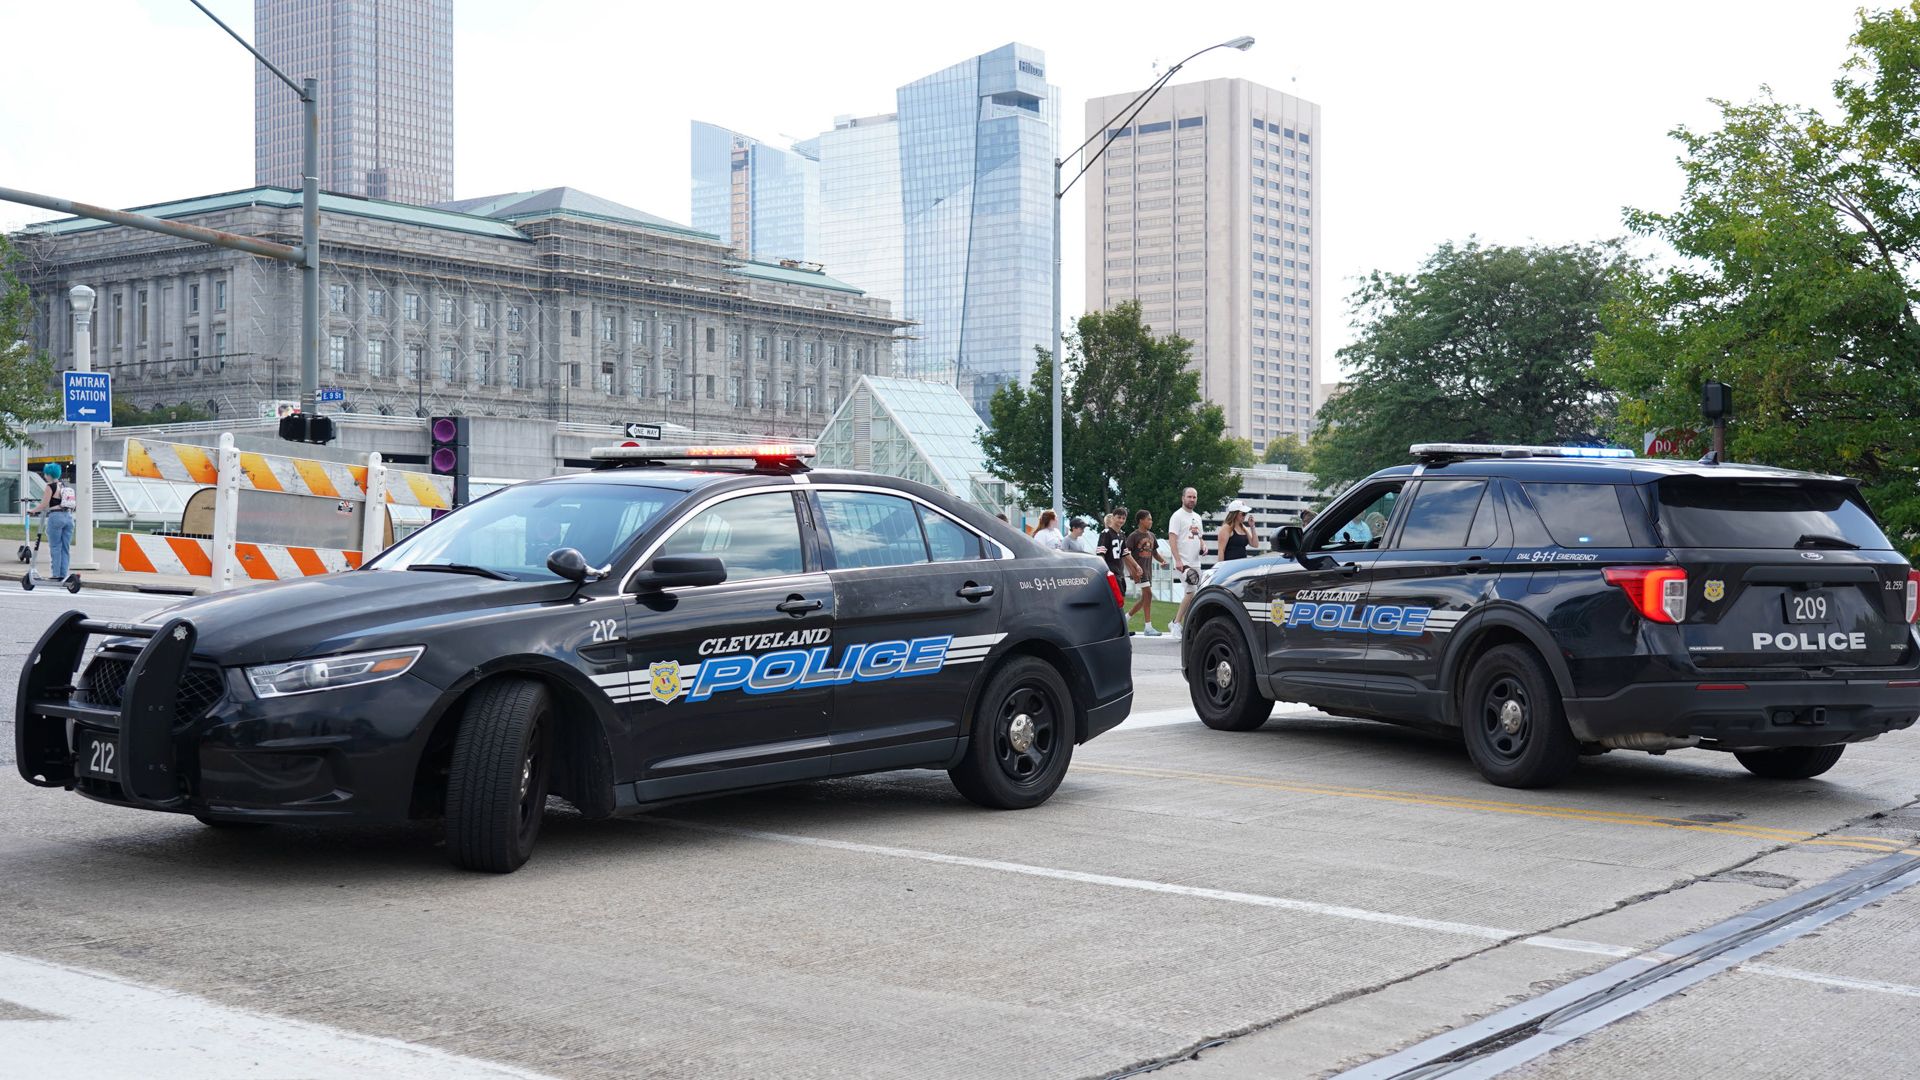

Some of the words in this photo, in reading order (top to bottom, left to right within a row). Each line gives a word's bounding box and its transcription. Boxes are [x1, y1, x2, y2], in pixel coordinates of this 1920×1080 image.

[1018, 60, 1043, 77] Hilton
[69, 376, 106, 388] AMTRAK
[69, 389, 106, 401] STATION
[329, 392, 334, 400] 9
[634, 427, 644, 435] ONE
[1655, 440, 1672, 453] DO
[1516, 552, 1531, 560] DIAL
[1531, 551, 1557, 562] 9-1-1
[1556, 553, 1599, 561] EMERGENCY
[1019, 581, 1034, 590] DIAL
[1034, 576, 1057, 591] 9-1-1
[1056, 577, 1089, 587] EMERGENCY
[1295, 589, 1360, 602] CLEVELAND
[1793, 596, 1827, 620] 209
[1285, 602, 1433, 636] POLICE
[589, 618, 619, 642] 212
[698, 627, 832, 656] CLEVELAND
[1752, 632, 1867, 650] POLICE
[685, 633, 955, 703] POLICE
[90, 740, 115, 774] 212
